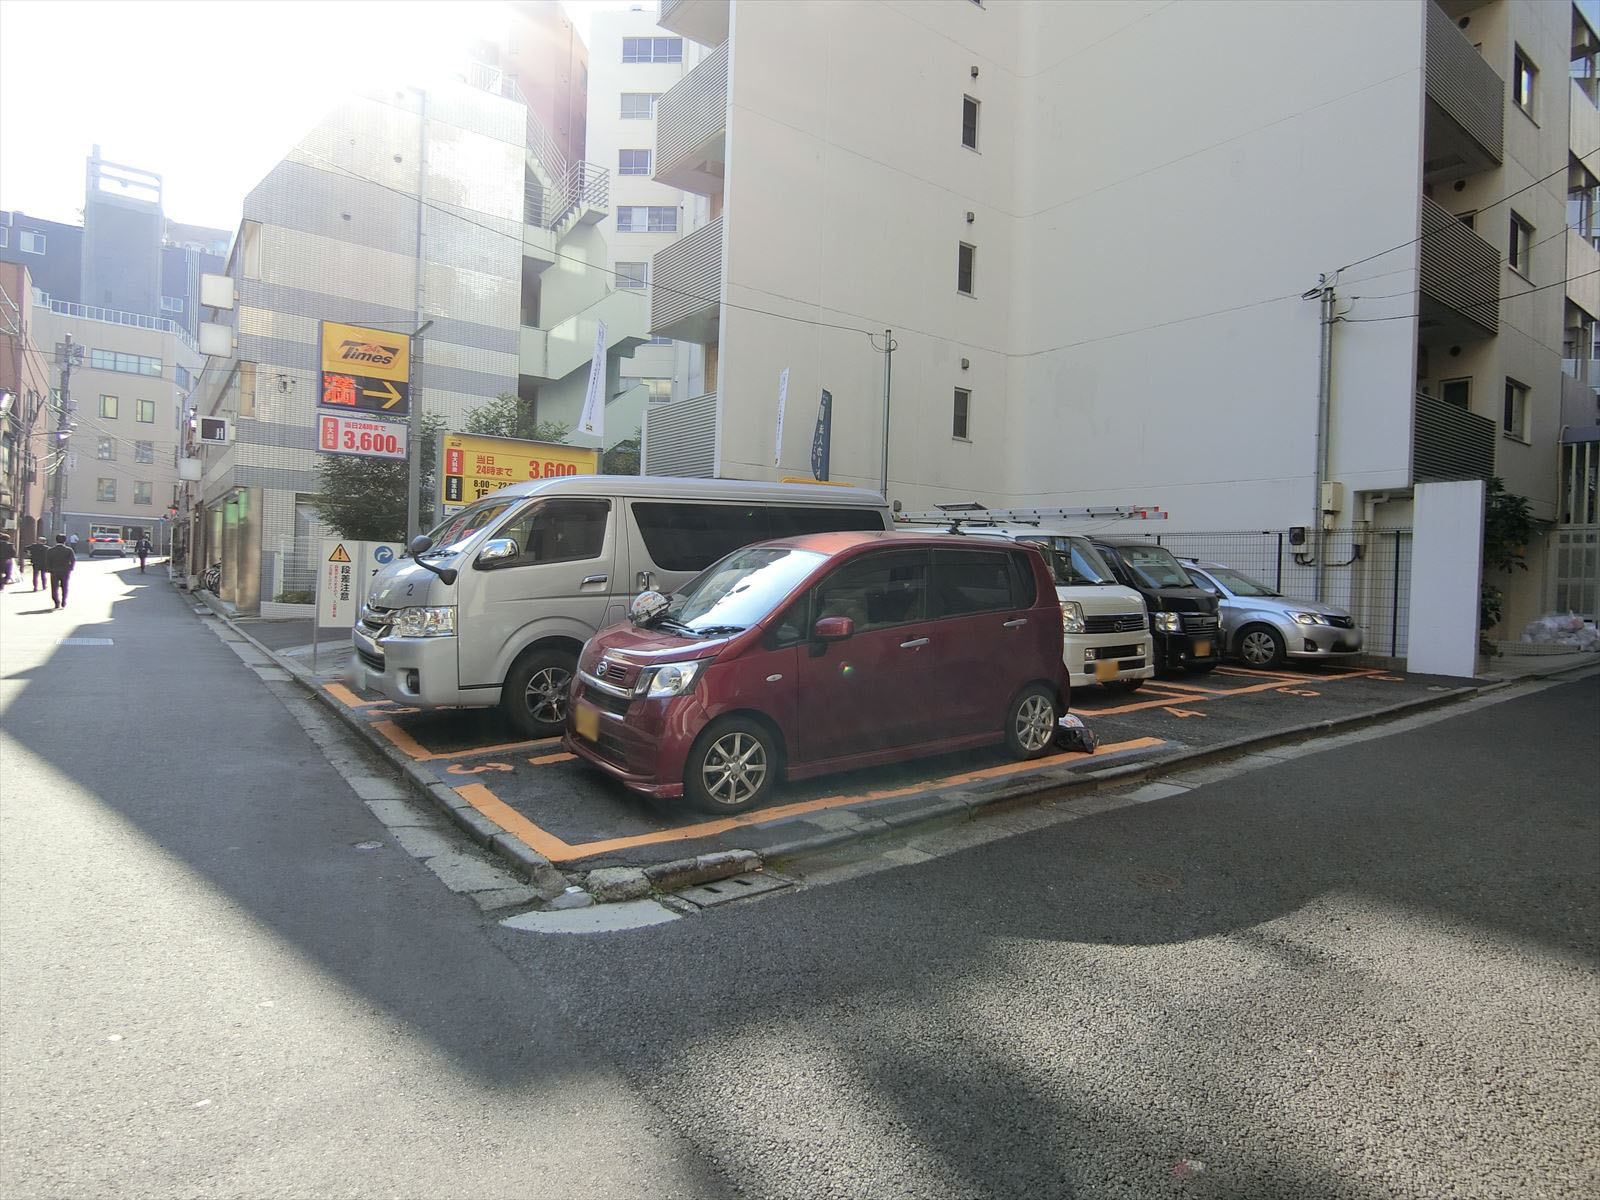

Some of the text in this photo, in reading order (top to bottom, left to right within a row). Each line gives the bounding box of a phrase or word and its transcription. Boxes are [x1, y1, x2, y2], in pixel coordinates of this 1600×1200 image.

[340, 340, 400, 365] Times
[476, 454, 495, 466] 当日
[475, 465, 513, 477] 24時まで
[340, 565, 351, 601] 段差注意
[406, 583, 414, 596] 2
[1163, 706, 1207, 718] 4
[446, 762, 514, 775] 3
